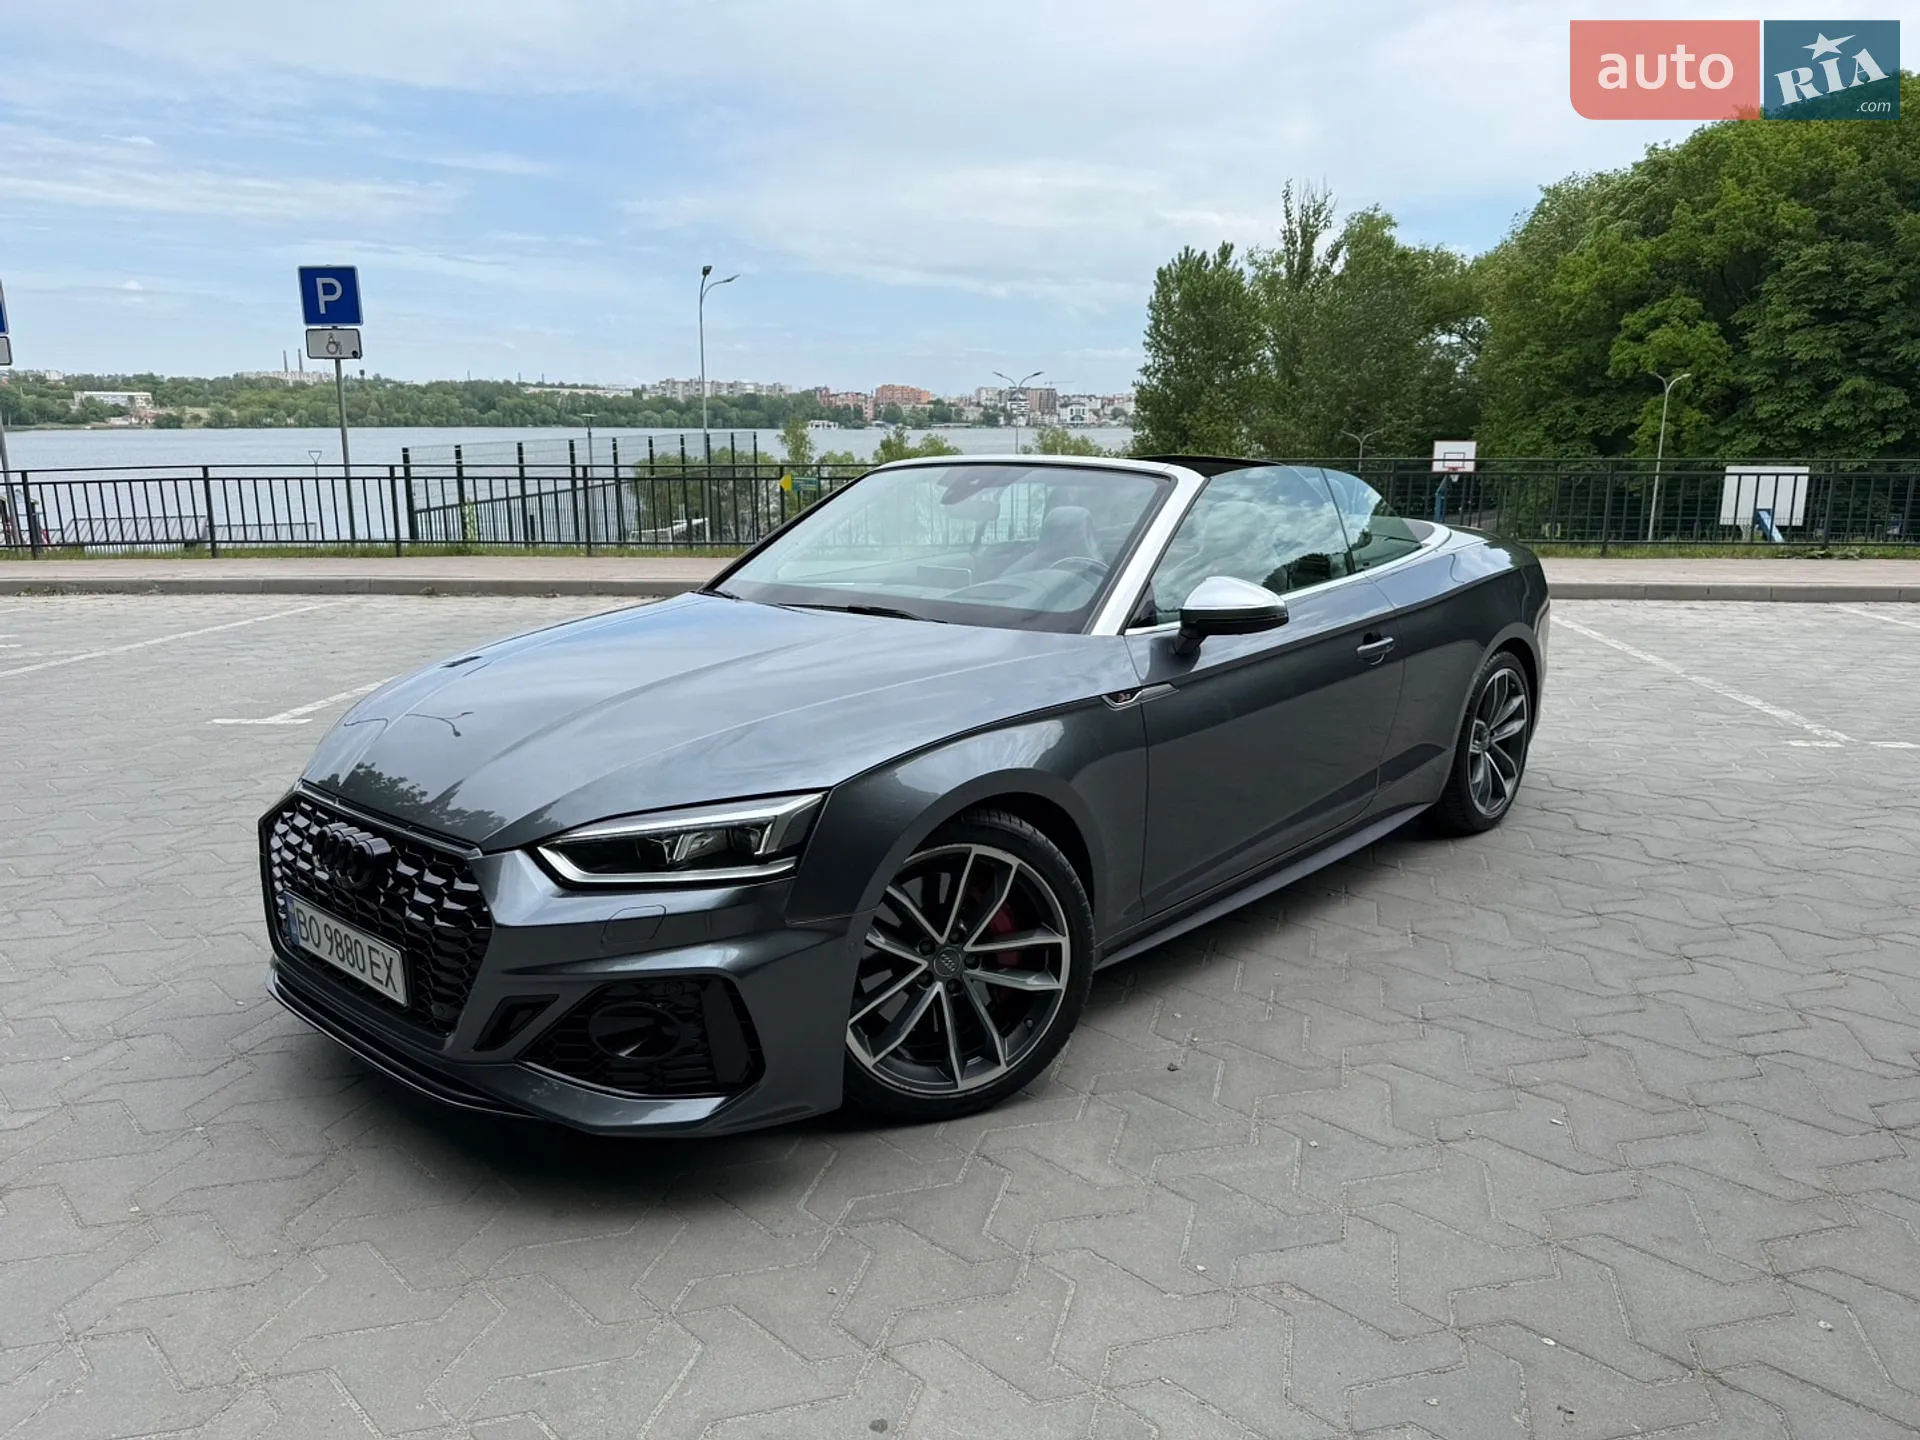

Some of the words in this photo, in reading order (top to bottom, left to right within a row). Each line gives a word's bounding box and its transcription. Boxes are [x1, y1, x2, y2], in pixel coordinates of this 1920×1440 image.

[316, 277, 342, 314] P
[296, 907, 321, 948] BO
[324, 923, 365, 974] 9880
[368, 945, 397, 993] EX
